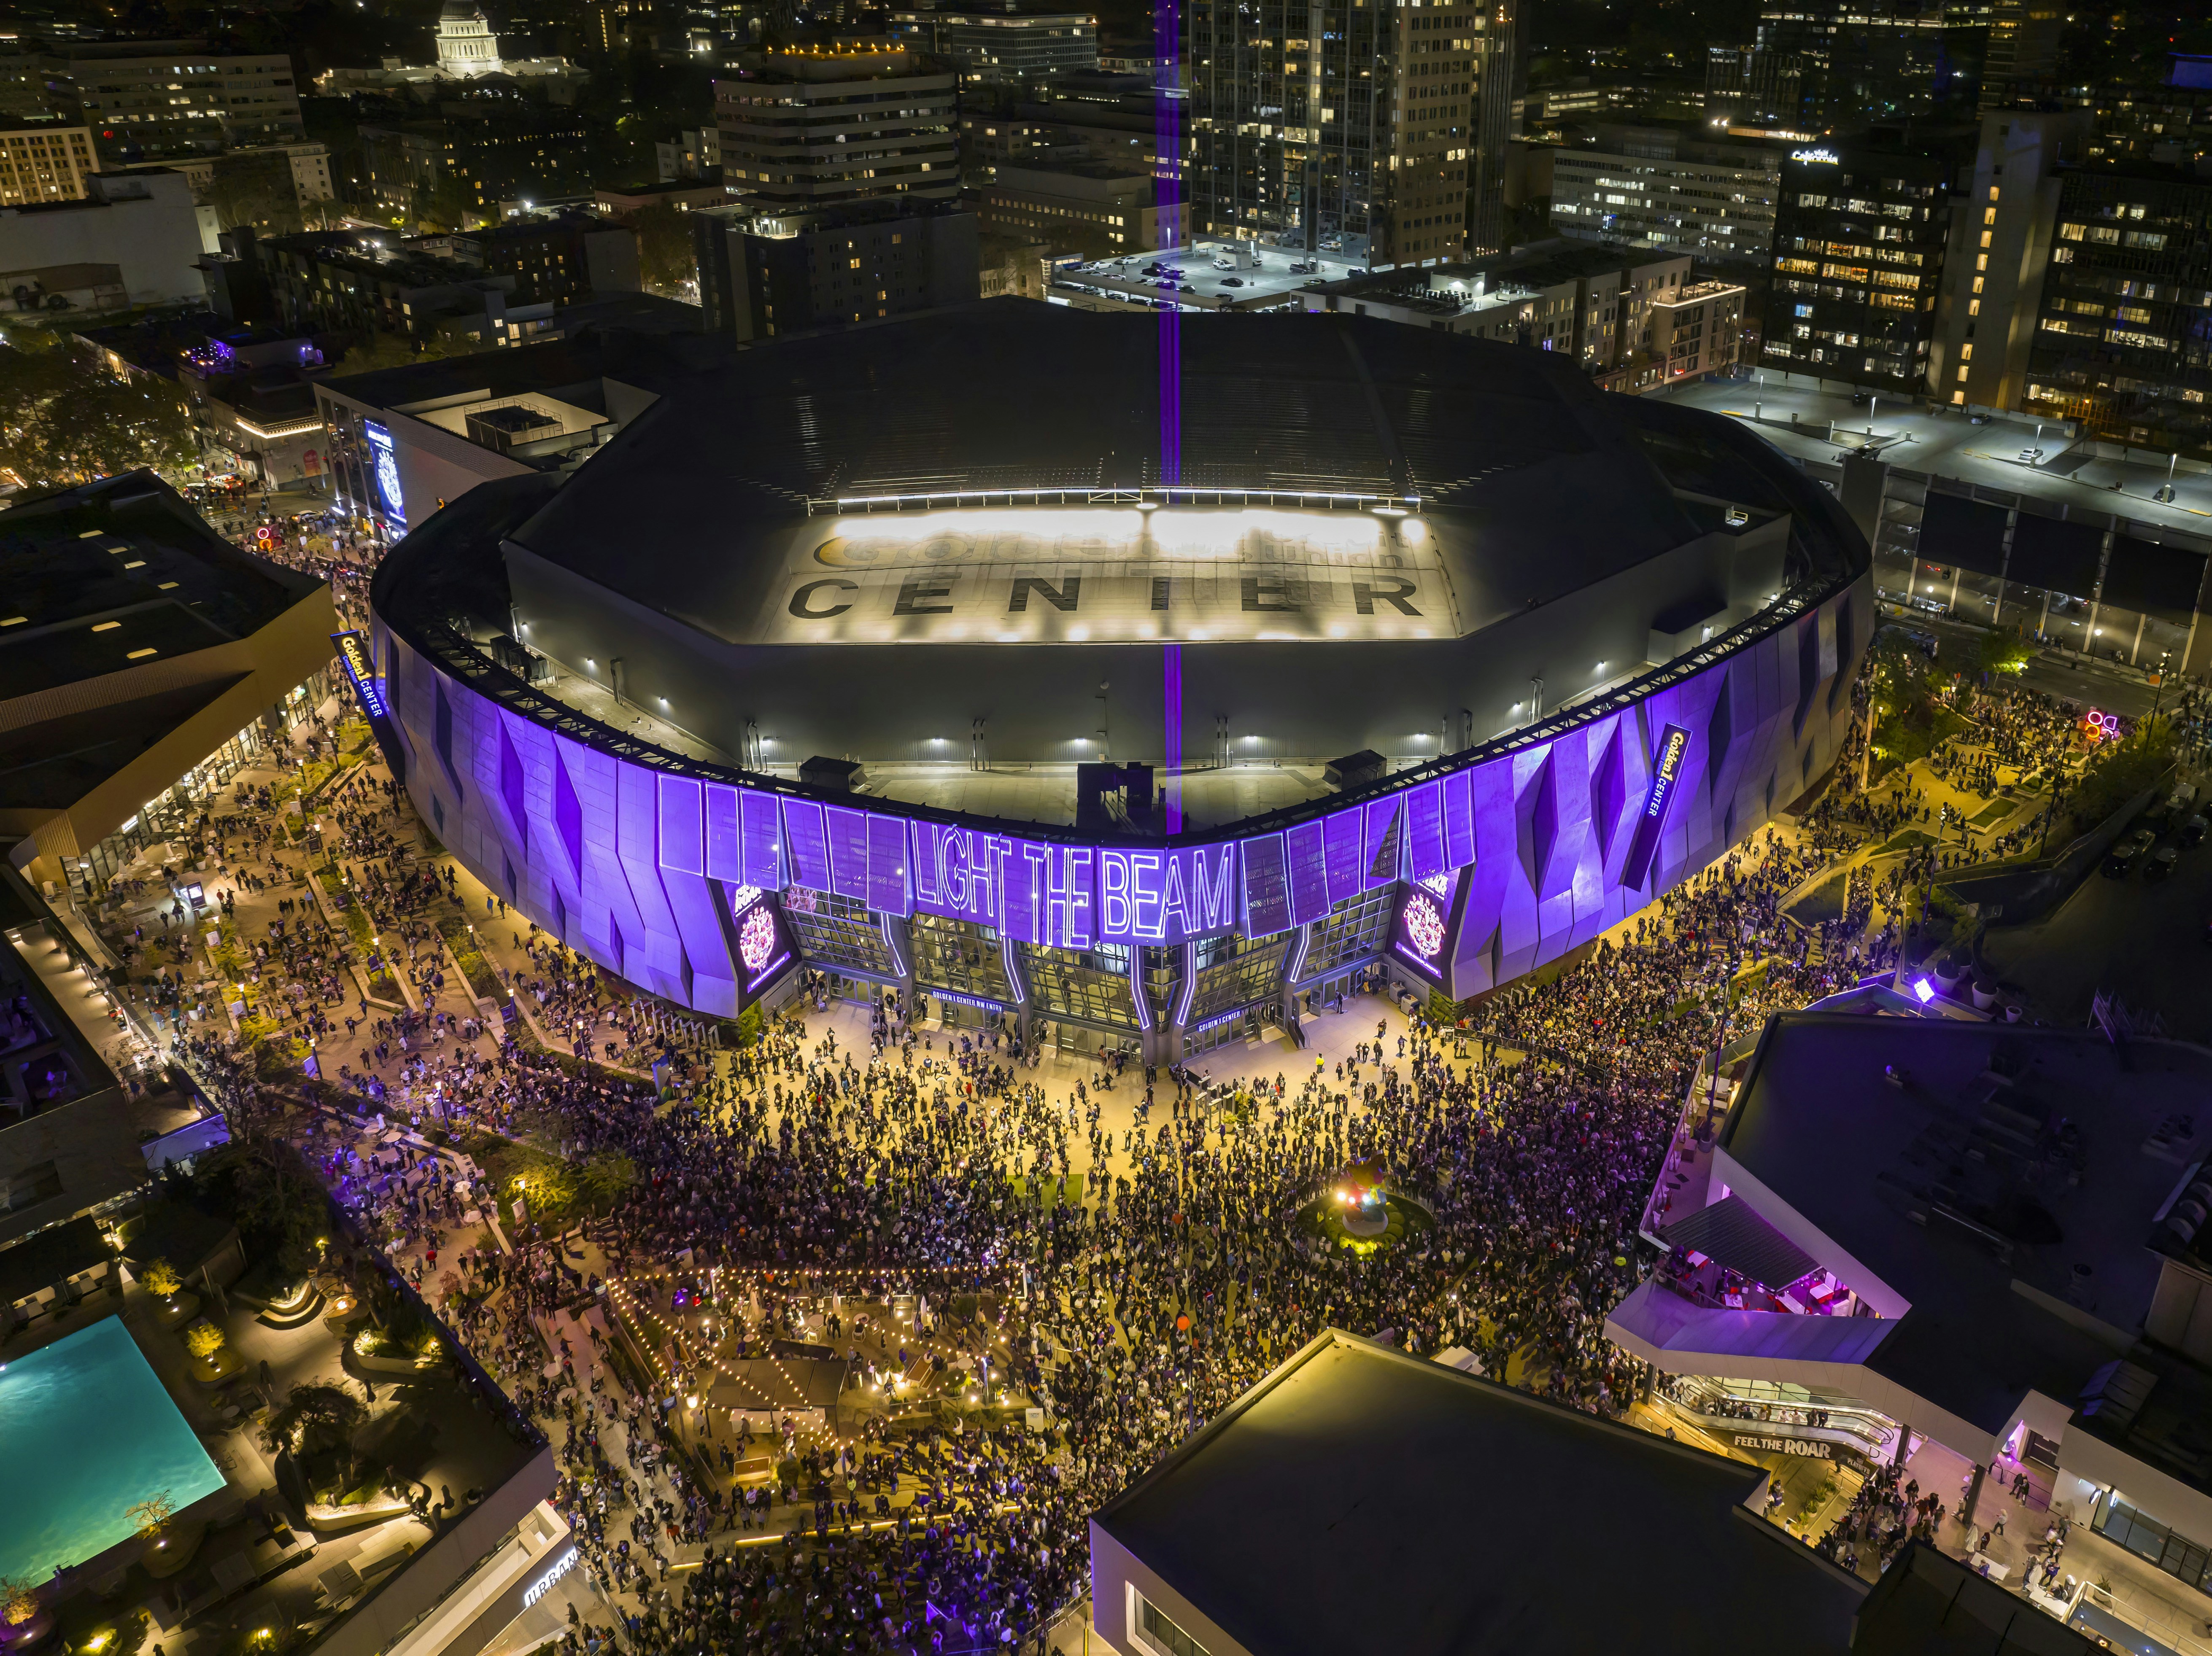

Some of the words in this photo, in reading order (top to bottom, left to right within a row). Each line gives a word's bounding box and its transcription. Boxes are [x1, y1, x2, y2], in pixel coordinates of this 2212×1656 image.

[788, 569, 1425, 619] CENTER
[361, 681, 383, 716] CENTER
[1648, 778, 1667, 816] CENTER
[911, 820, 1012, 936] LIGHT
[1024, 843, 1092, 948] THE
[1102, 843, 1234, 938] BEAM
[933, 991, 952, 1001] GOLDEN
[957, 996, 975, 1006] CENTER
[986, 1003, 1002, 1012] ENTRY
[1199, 1019, 1218, 1032] GOLDEN
[1222, 1011, 1241, 1023] CENTER
[1735, 1435, 1760, 1448] FEEL
[1761, 1438, 1783, 1451] THE
[1784, 1439, 1831, 1459] ROAR
[1847, 1458, 1870, 1475] PLAYOFFS
[526, 1548, 577, 1607] URBAN
